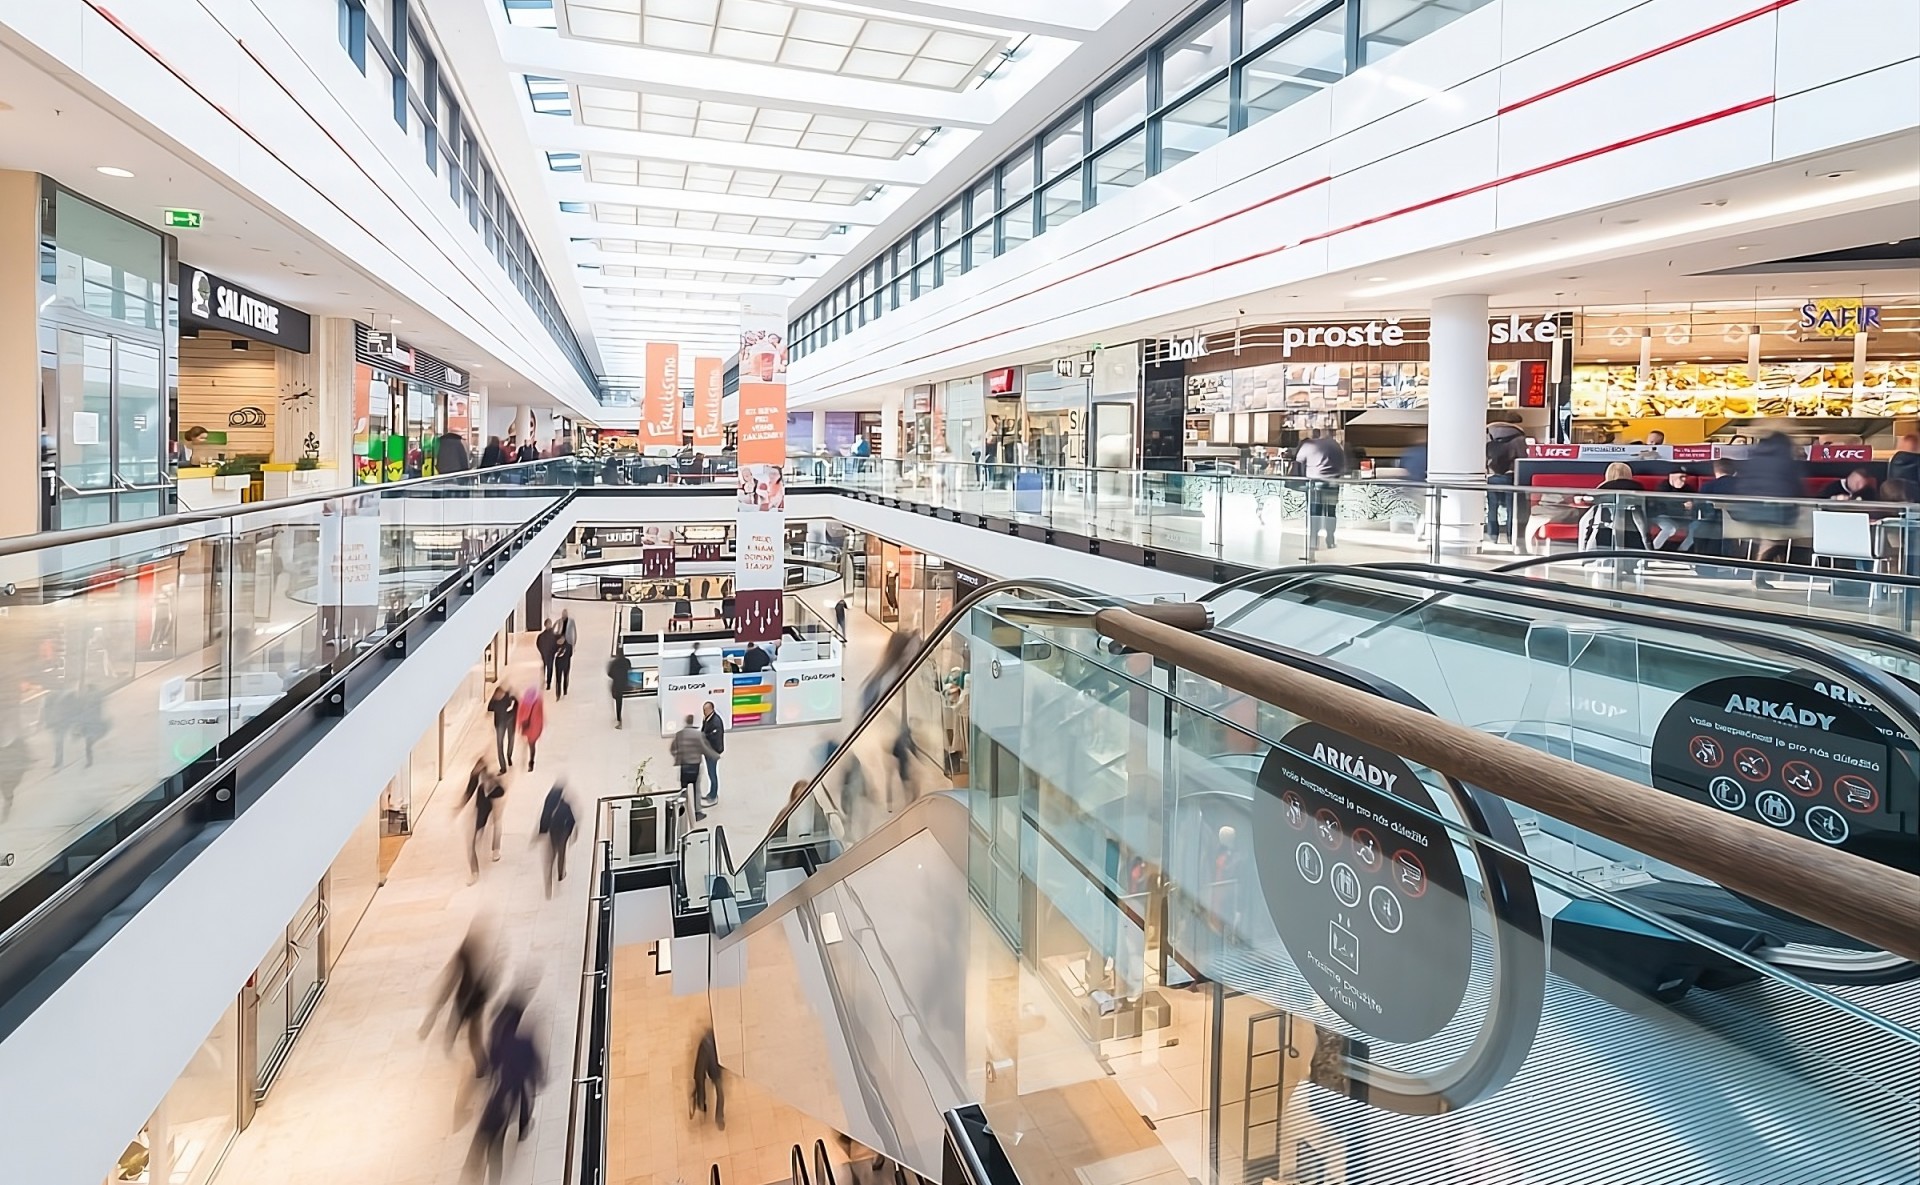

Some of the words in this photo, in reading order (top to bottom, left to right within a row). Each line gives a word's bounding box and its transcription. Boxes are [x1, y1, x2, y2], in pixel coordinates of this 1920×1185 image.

[216, 285, 279, 335] SALATERIE
[1799, 303, 1881, 329] SAFIR
[1168, 328, 1210, 361] bok
[1282, 315, 1404, 358] prostě
[1489, 311, 1558, 344] ské
[1544, 448, 1572, 457] KFC
[1834, 449, 1865, 459] KFC
[1814, 681, 1872, 706] ARK
[1724, 693, 1837, 731] ARKÁDY
[1788, 742, 1807, 752] pro
[1312, 742, 1398, 794] ARKÁDY
[1356, 805, 1372, 818] pro
